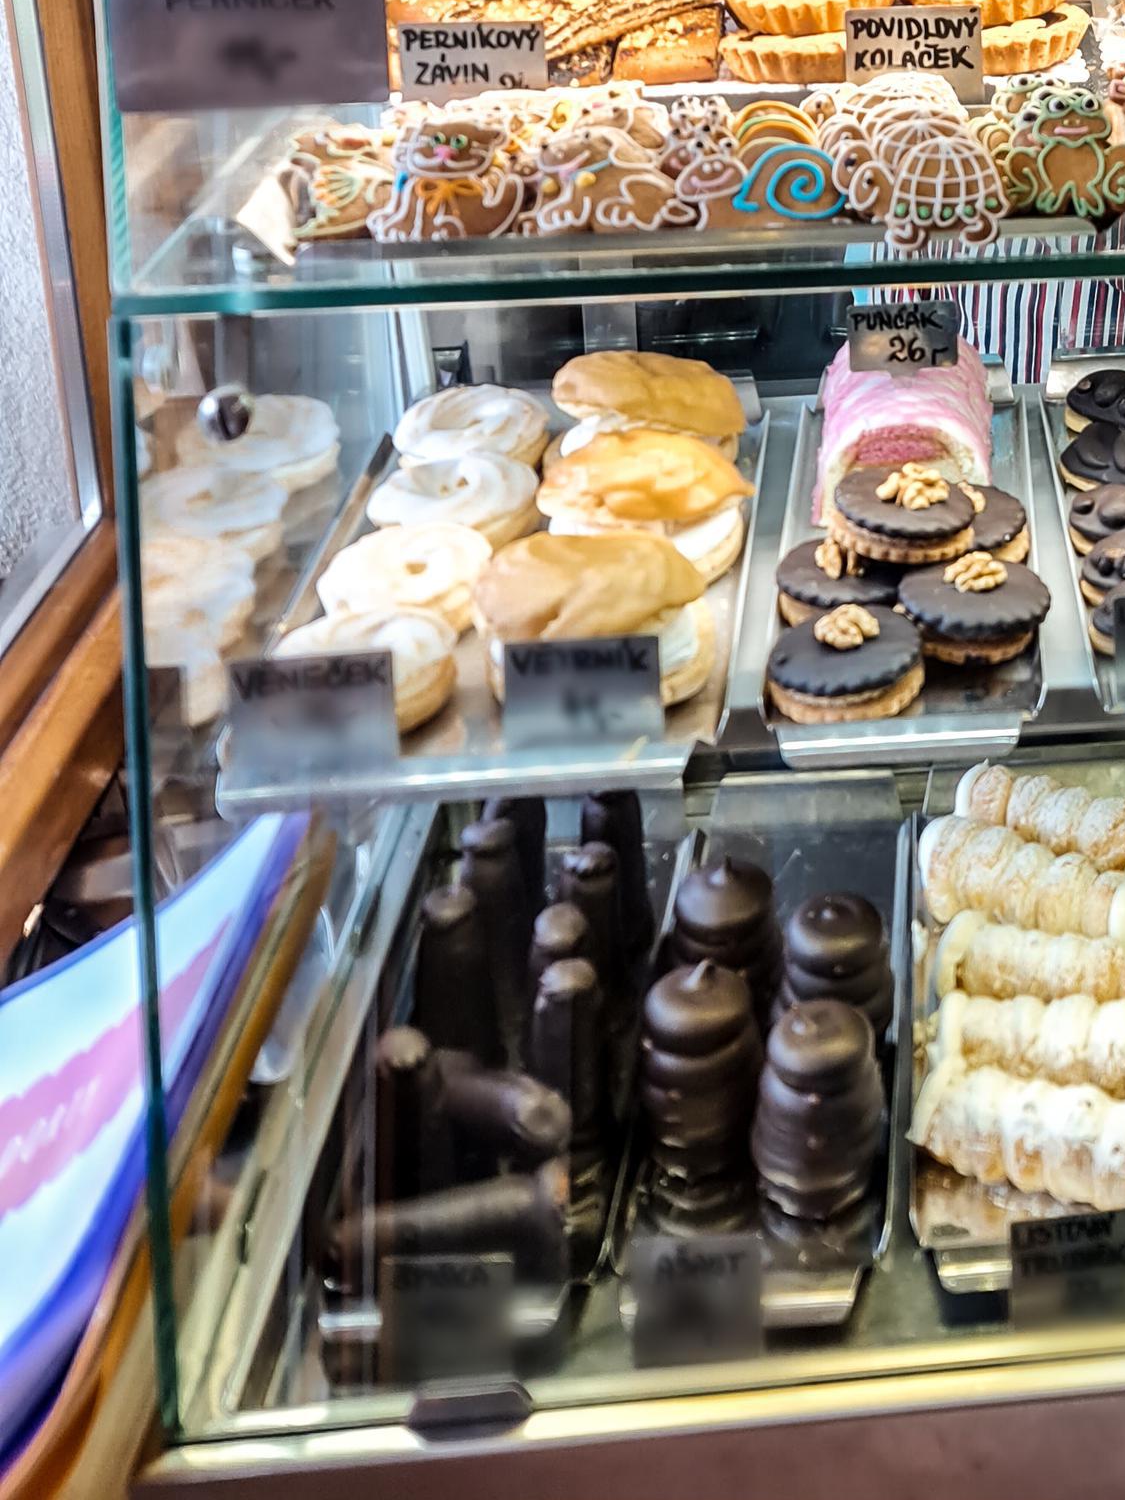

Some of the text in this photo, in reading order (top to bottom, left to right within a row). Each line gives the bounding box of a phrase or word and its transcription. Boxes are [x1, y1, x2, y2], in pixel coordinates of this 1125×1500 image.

[402, 23, 540, 52] PERNÍKOVÝ
[850, 7, 978, 40] POVIDLOVÝ
[415, 53, 490, 86] ZÁVIN
[854, 40, 975, 71] KOLÁČEK
